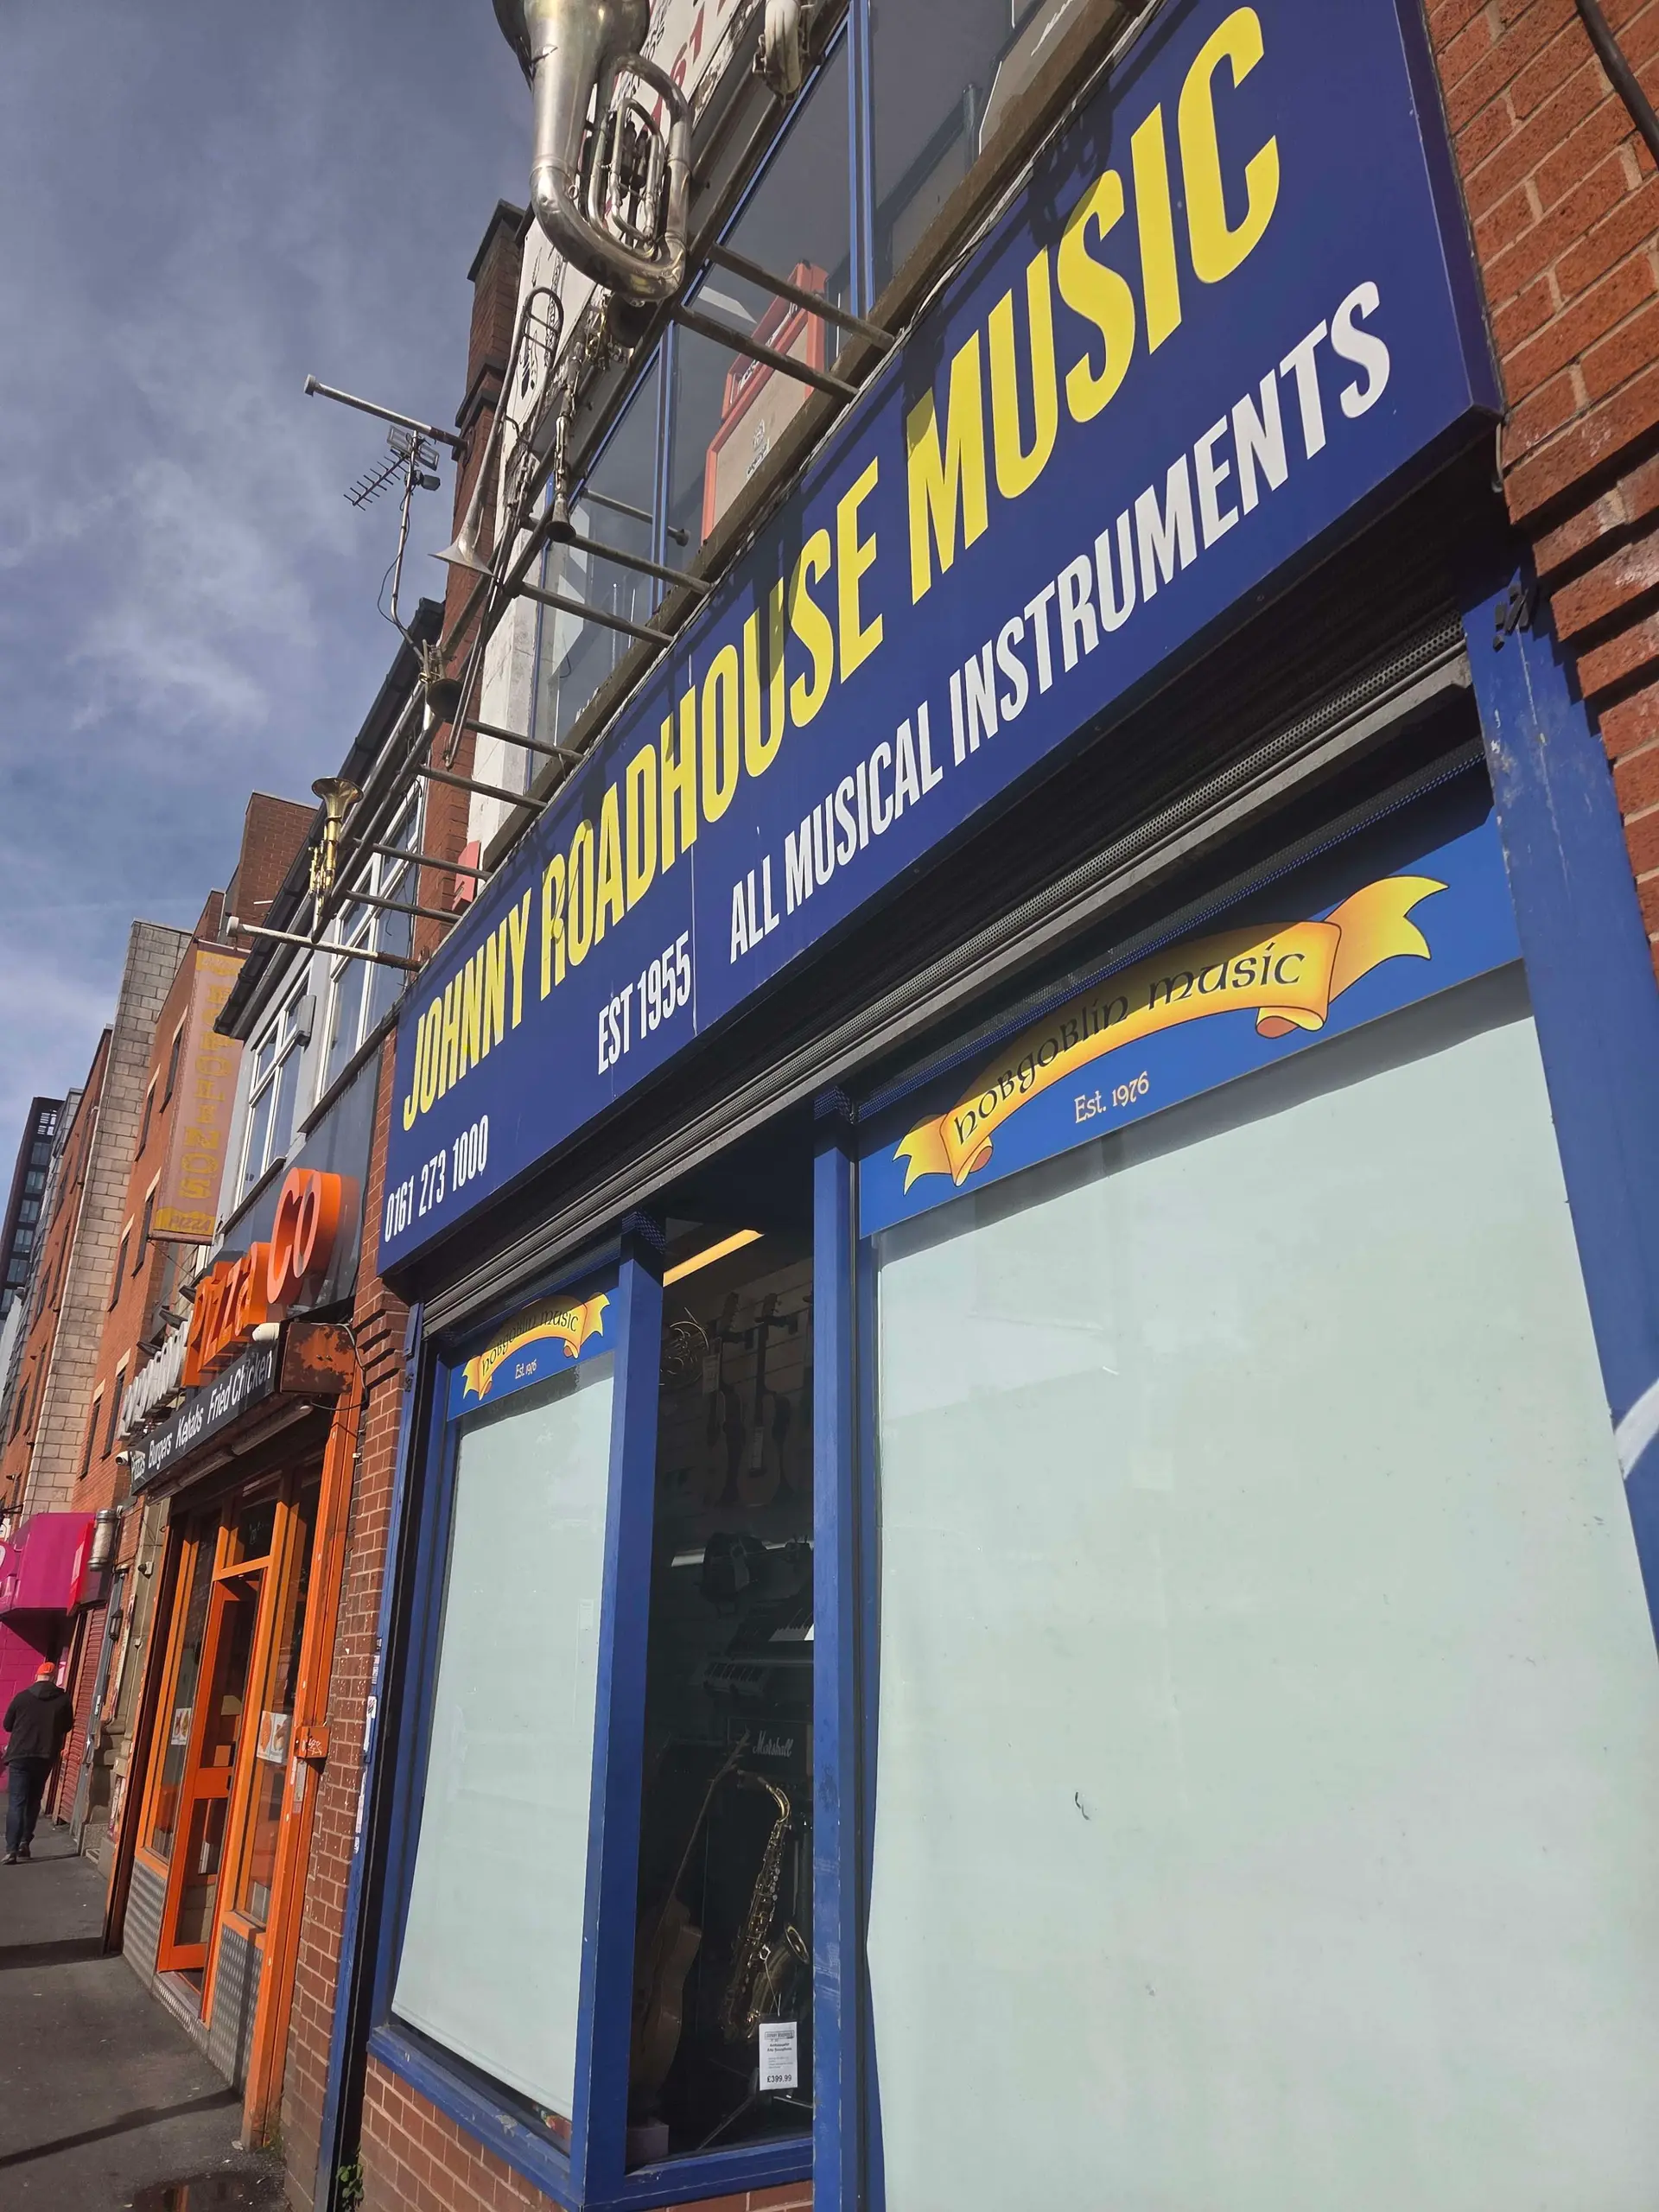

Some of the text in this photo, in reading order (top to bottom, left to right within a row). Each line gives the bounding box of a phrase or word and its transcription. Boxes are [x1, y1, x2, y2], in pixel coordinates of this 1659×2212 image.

[403, 6, 1280, 1131] JOHNNY ROADHOUSE MUSIC
[730, 855, 780, 964] ALL
[785, 701, 944, 915] MUSICAL
[950, 281, 1390, 767] INSTRUMENTS
[598, 930, 691, 1075] EST 1955
[1147, 943, 1306, 1009] music
[1074, 1071, 1150, 1124] Est. 1976
[385, 1114, 489, 1243] 0161 273 1000
[148, 1432, 173, 1471] Burgers
[175, 1404, 205, 1450] Kebabs
[207, 1376, 233, 1424] Fried
[232, 1350, 273, 1405] Chicken
